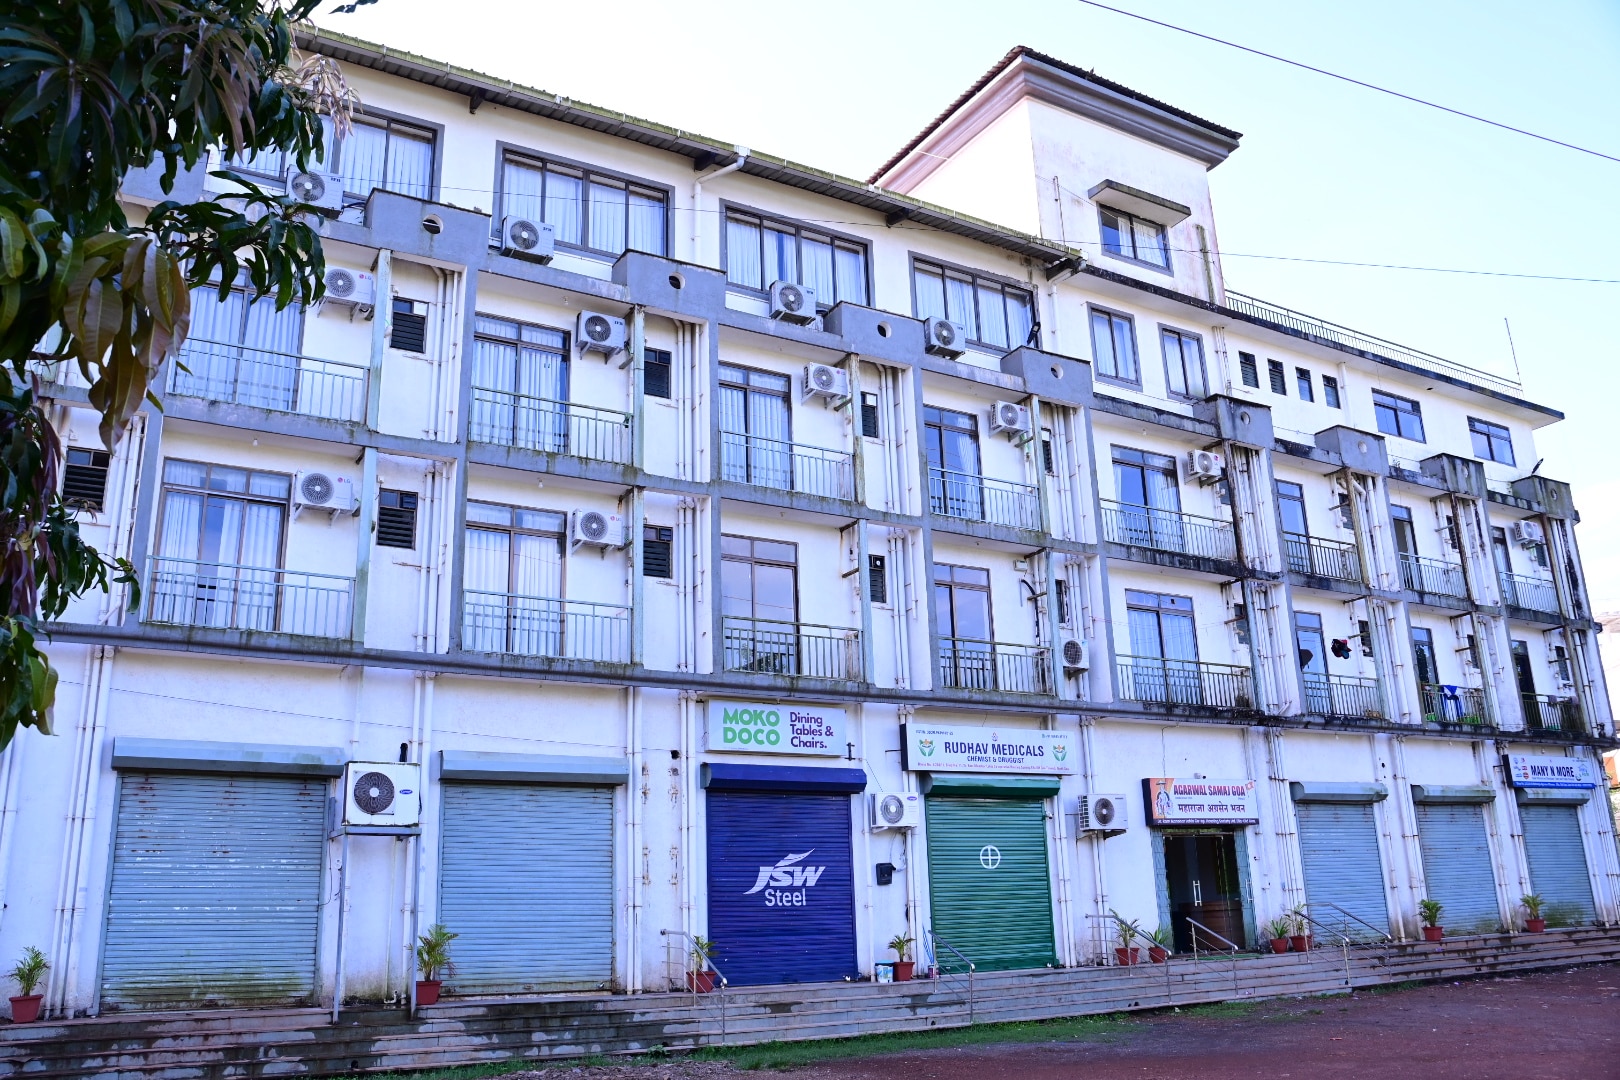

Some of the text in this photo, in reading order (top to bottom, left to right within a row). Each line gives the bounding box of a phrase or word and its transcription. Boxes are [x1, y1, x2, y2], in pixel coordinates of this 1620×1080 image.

[723, 707, 780, 727] MOKO
[789, 712, 823, 727] Dining
[723, 727, 780, 746] DOCO
[789, 724, 834, 737] Tables &
[790, 736, 828, 749] Chairs.
[944, 741, 1045, 757] RUDHAV MEDICALS
[967, 755, 991, 763] CHEMIST
[1530, 765, 1549, 777] MANY
[1549, 766, 1556, 777] N
[1556, 766, 1575, 778] MORE
[1173, 785, 1246, 797] AGARWAL SAMAJ GOA
[1177, 801, 1246, 813] महाराजा अग्रसेन भवन
[742, 866, 826, 895] JSW
[764, 888, 807, 907] Steel
